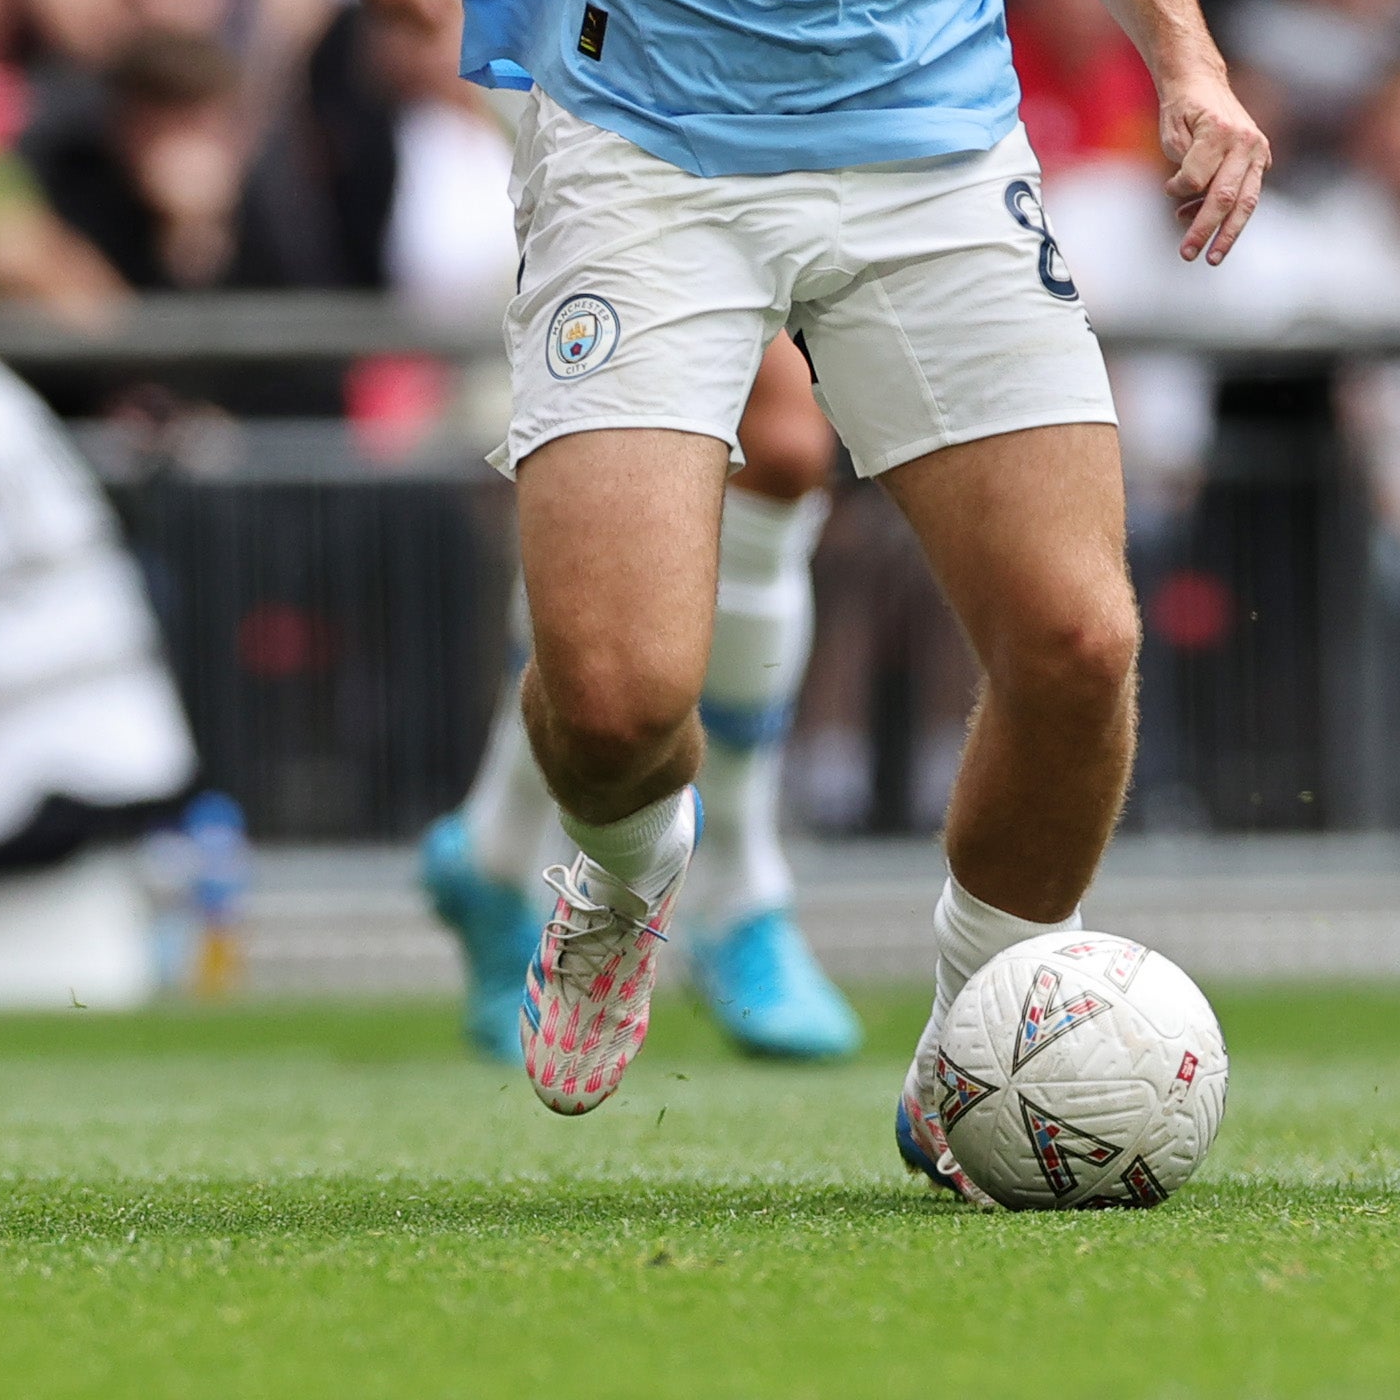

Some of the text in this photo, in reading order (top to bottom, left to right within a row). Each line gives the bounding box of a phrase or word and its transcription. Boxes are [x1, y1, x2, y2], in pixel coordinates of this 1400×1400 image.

[1003, 179, 1080, 302] 8
[552, 300, 610, 336] MANCHESTER
[565, 362, 588, 375] CITY
